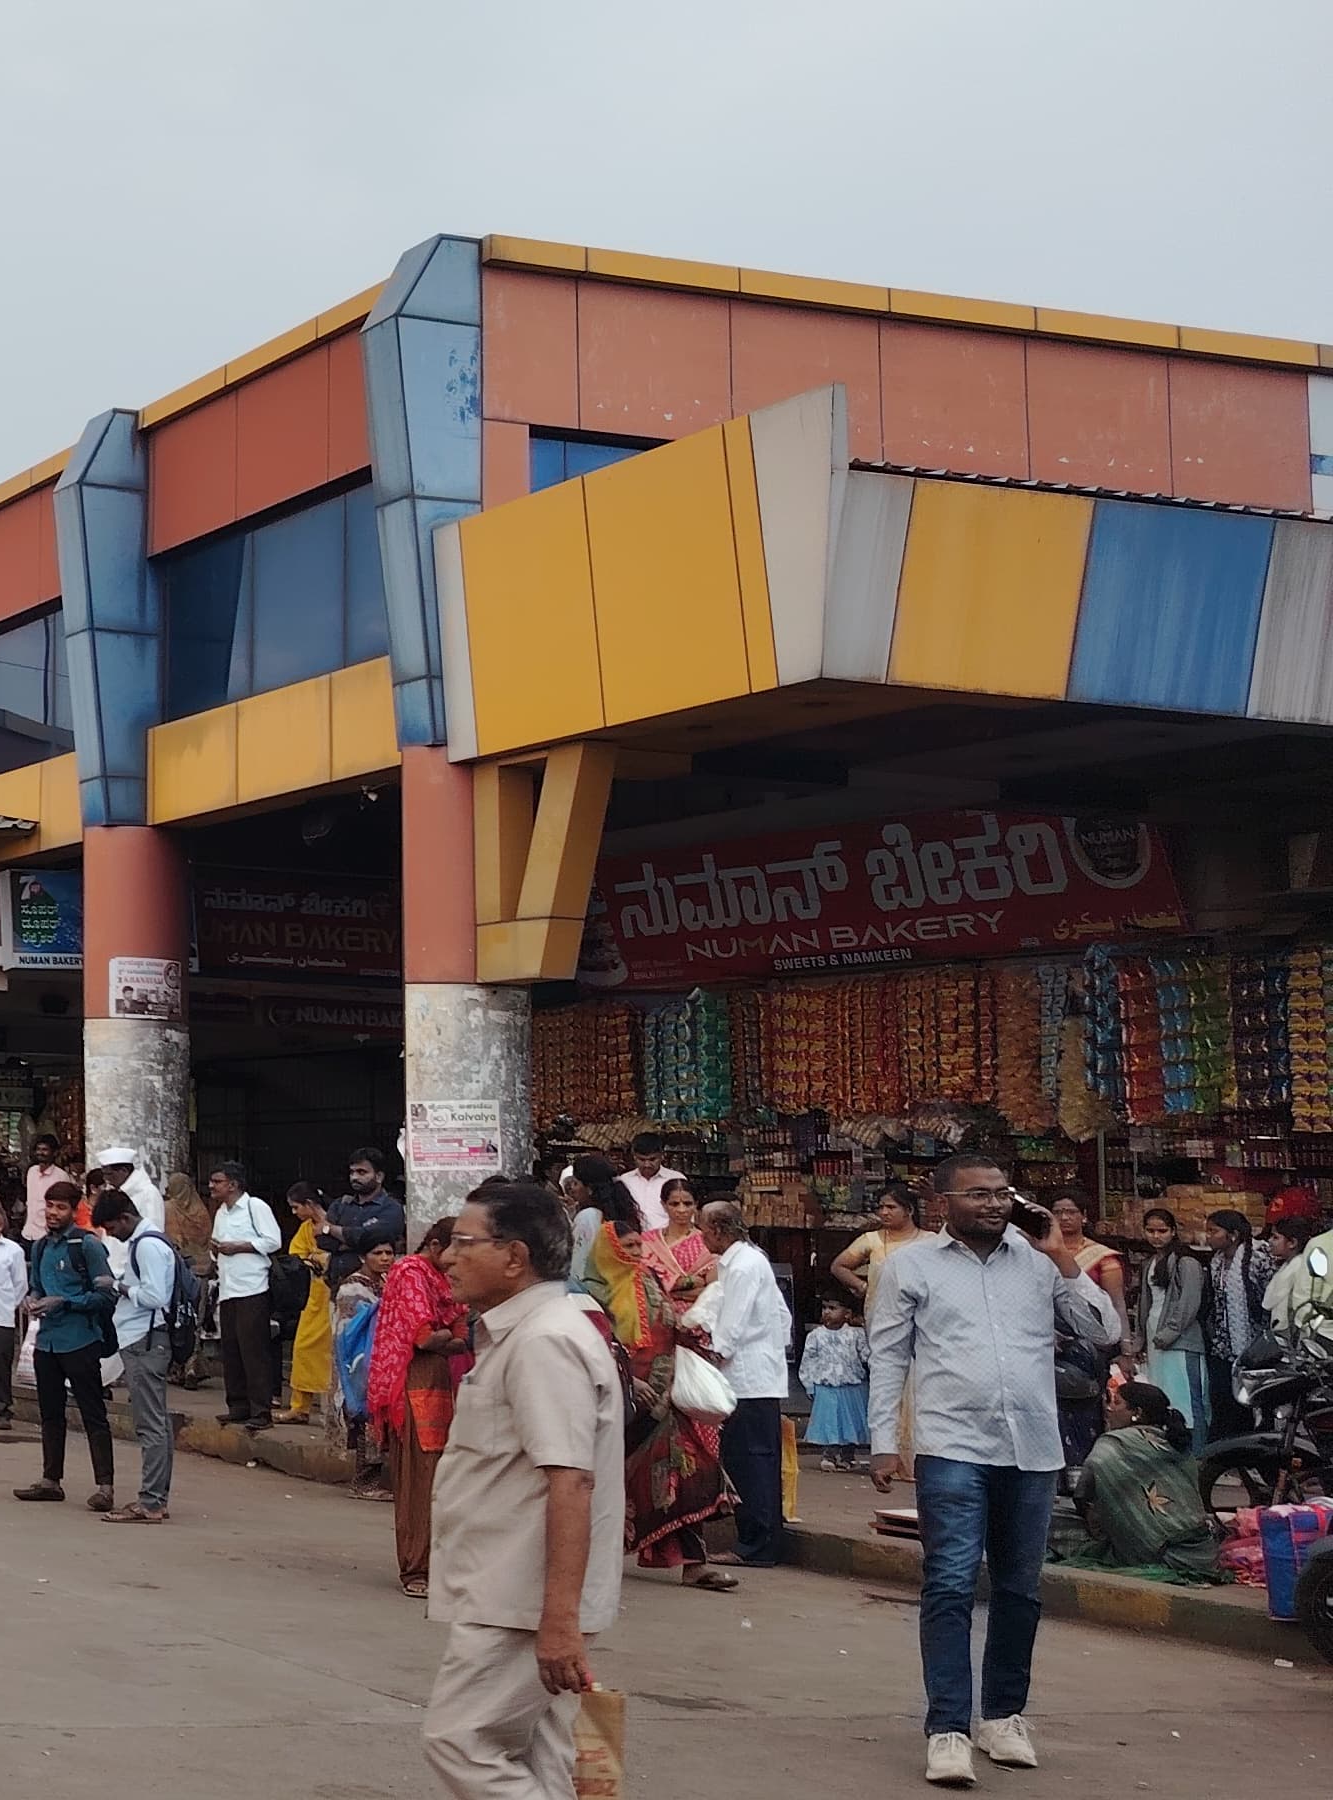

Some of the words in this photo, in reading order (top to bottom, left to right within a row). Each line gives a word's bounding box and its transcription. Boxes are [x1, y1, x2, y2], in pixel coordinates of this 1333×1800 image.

[613, 840, 850, 939] ನುಮಾನ್
[864, 811, 1069, 912] ಬೇಕರಿ
[199, 918, 278, 947] UMAN
[284, 922, 399, 954] BAKERY
[684, 928, 821, 962] NUMAN
[828, 910, 1006, 951] BAKERY
[19, 956, 51, 965] NUMAN
[773, 954, 827, 972] SWEETS
[829, 954, 839, 966] &
[840, 946, 914, 966] NAMKEEN
[295, 1005, 364, 1025] NUMAN
[364, 1009, 402, 1028] BAK
